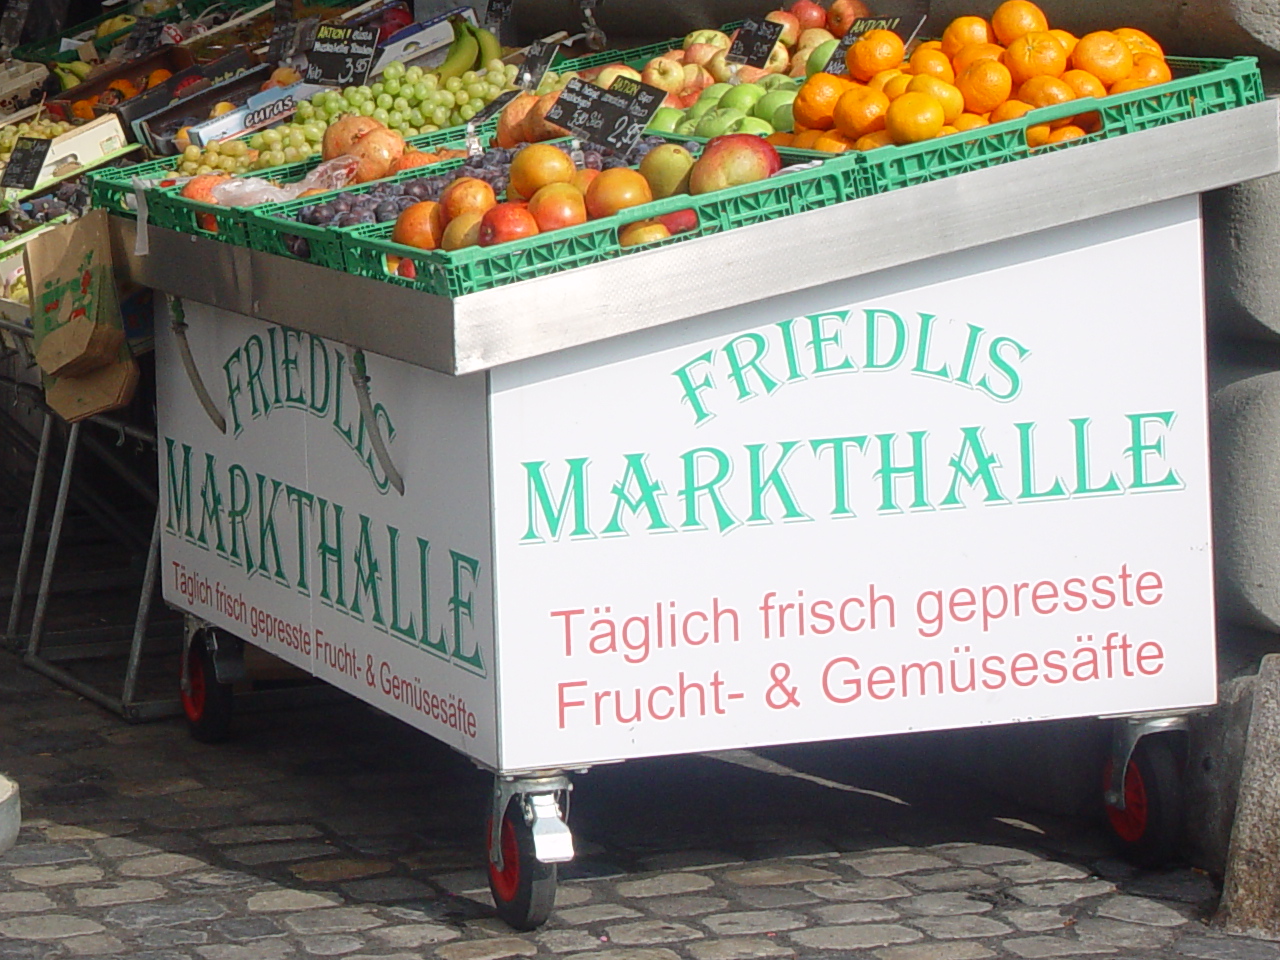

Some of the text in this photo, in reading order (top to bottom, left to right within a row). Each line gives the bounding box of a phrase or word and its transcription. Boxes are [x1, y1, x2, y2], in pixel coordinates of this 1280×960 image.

[672, 308, 1032, 427] FRIEDLIS
[519, 410, 1185, 545] MARKTHALLE
[165, 436, 487, 678] MARKTHALLE
[550, 563, 1164, 665] Täglich frisch gepresste
[172, 561, 477, 739] Täglich frisch gepresste Frucht- & Gemüsesäfte
[556, 632, 1166, 729] Frucht- & Gemüsesäfte
